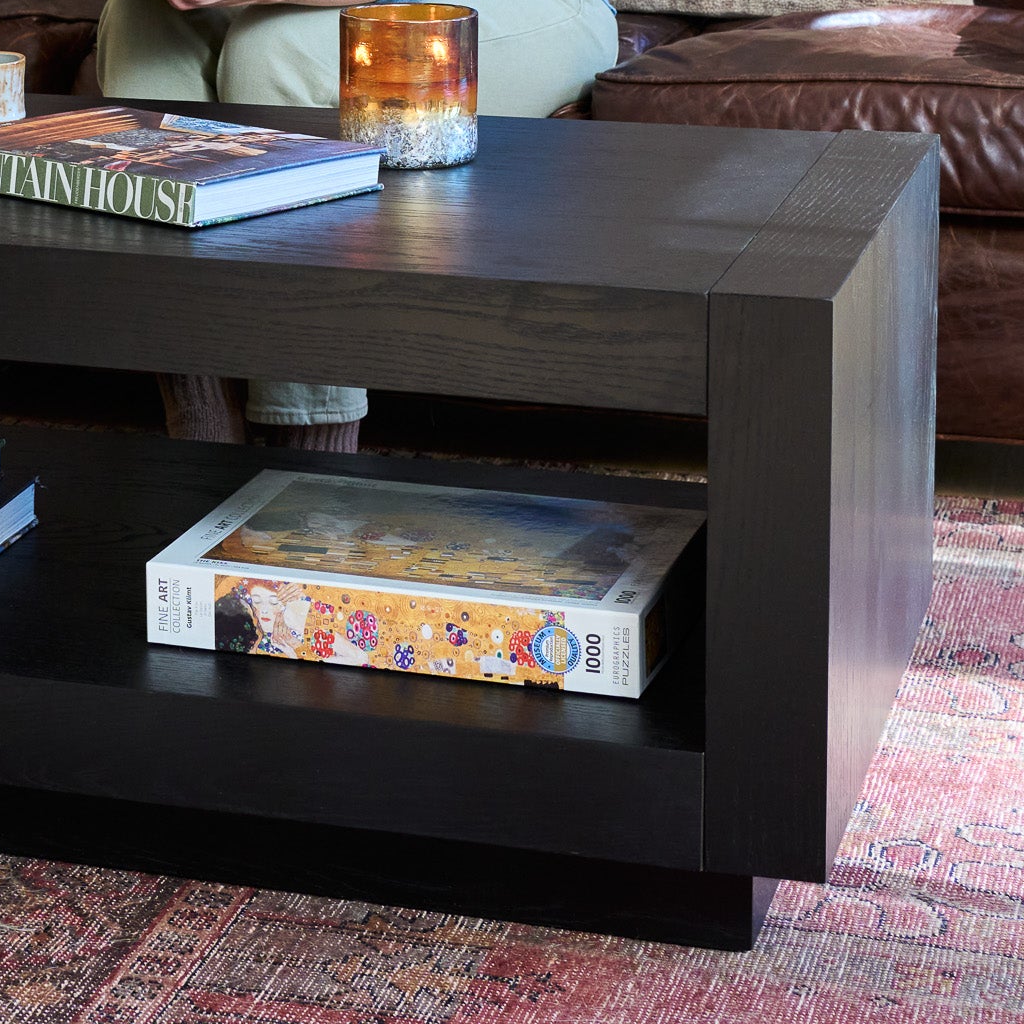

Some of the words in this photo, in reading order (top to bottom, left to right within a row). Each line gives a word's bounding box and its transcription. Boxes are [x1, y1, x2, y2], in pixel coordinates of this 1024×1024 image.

[80, 166, 196, 226] HOUSE
[158, 578, 169, 603] ART
[172, 579, 181, 634] COLLECTION
[158, 606, 169, 632] FINE
[533, 631, 547, 666] MUSEUM
[567, 638, 579, 667] QUALITY
[585, 633, 601, 674] 1000
[612, 626, 621, 685] EUROGRAPHICS
[621, 627, 630, 686] PUZZLES
